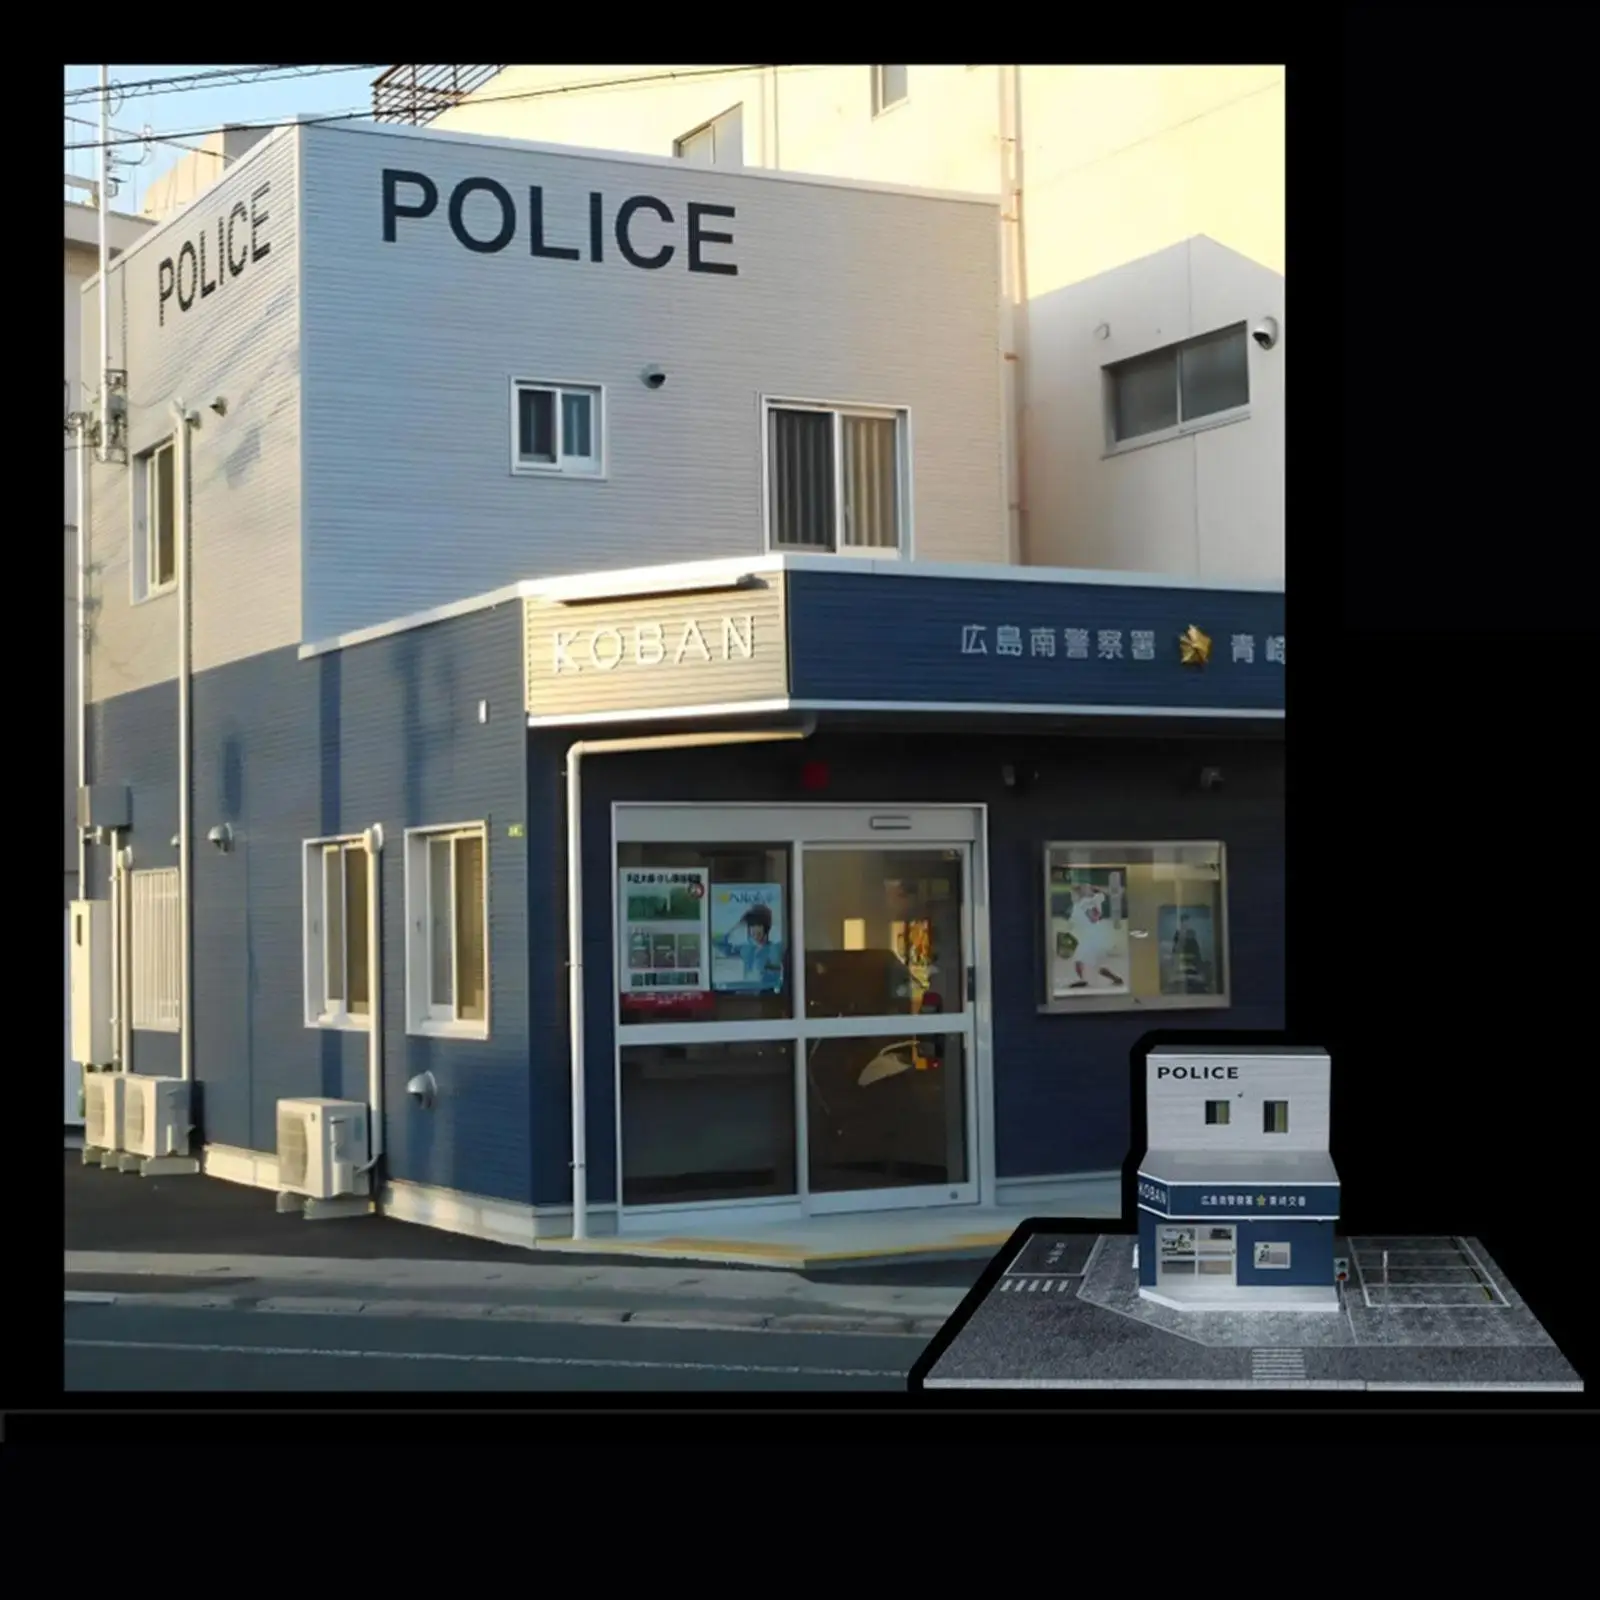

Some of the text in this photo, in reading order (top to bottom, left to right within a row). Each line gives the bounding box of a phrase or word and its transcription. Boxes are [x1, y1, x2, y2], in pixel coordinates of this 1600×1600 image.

[381, 167, 738, 276] POLICE
[158, 181, 271, 326] POLICE
[550, 613, 756, 675] KOBAN
[960, 624, 1156, 661] 広島南警察署
[1157, 1066, 1240, 1080] POLICE
